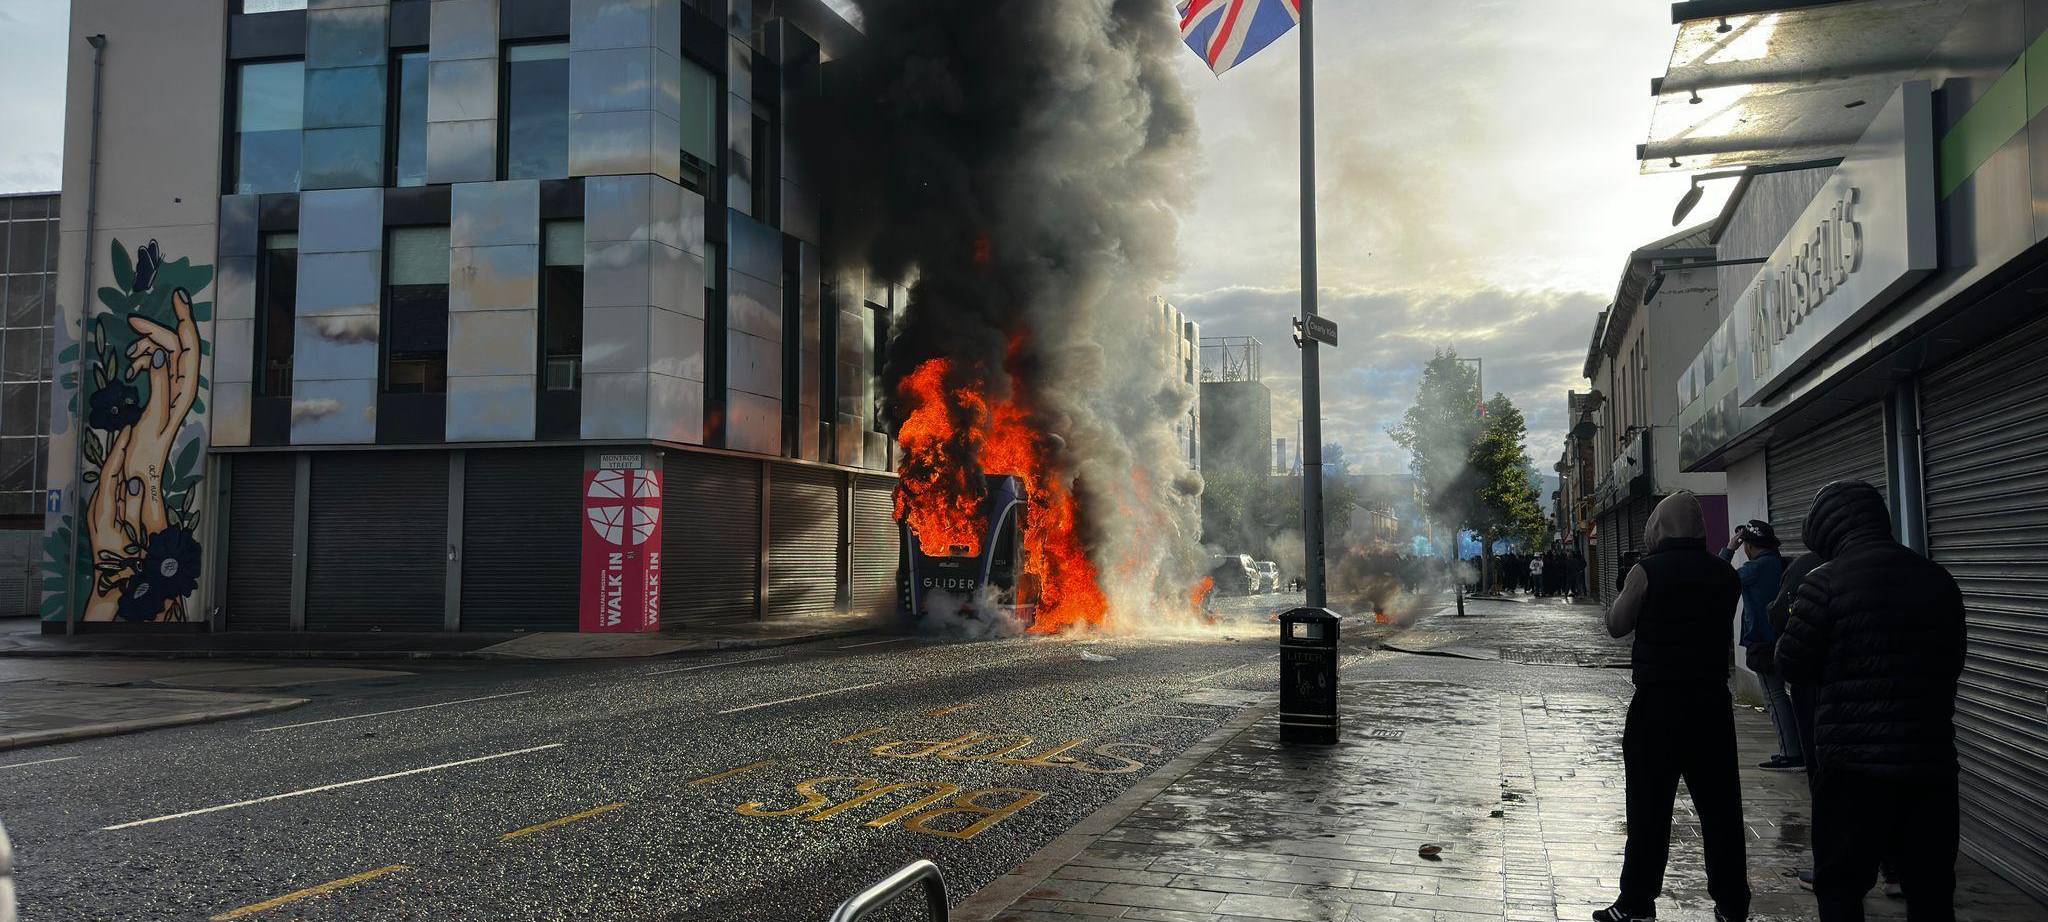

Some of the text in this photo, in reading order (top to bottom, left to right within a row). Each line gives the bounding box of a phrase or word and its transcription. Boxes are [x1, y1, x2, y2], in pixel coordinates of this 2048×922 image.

[607, 553, 622, 626] WALK IN
[649, 552, 658, 625] WALK IN
[923, 577, 975, 589] GLIDER
[869, 731, 1163, 774] STOP
[736, 776, 1046, 840] BUS
